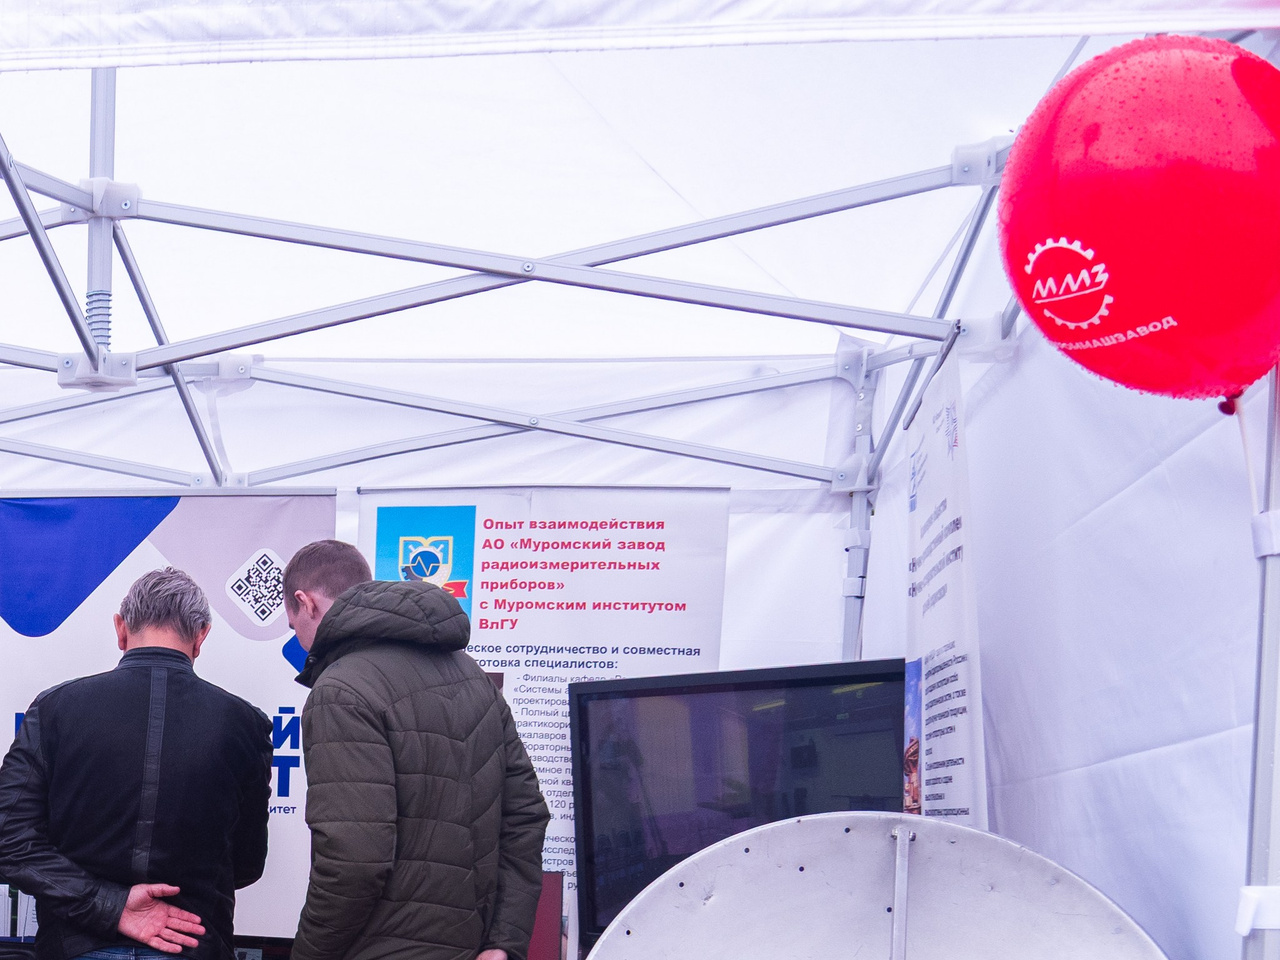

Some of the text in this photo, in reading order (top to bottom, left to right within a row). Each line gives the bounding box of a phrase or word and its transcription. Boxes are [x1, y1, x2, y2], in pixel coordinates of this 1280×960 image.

[1032, 262, 1109, 303] ММЗ
[483, 517, 665, 531] Опыт взаимодействия
[482, 537, 666, 552] АО «Муромский завод
[481, 560, 660, 573] радиоизмерительных
[480, 579, 565, 592] приборов»
[479, 599, 687, 613] с Муромским институтом
[479, 618, 518, 630] ВлГУ
[505, 645, 607, 656] сотрудничество
[611, 646, 619, 654] и
[623, 646, 701, 656] совместная
[524, 659, 618, 670] специалистов:
[522, 673, 567, 683] Филиалы
[514, 685, 562, 694] «Системы
[521, 708, 559, 717] Полный
[550, 801, 566, 809] 120
